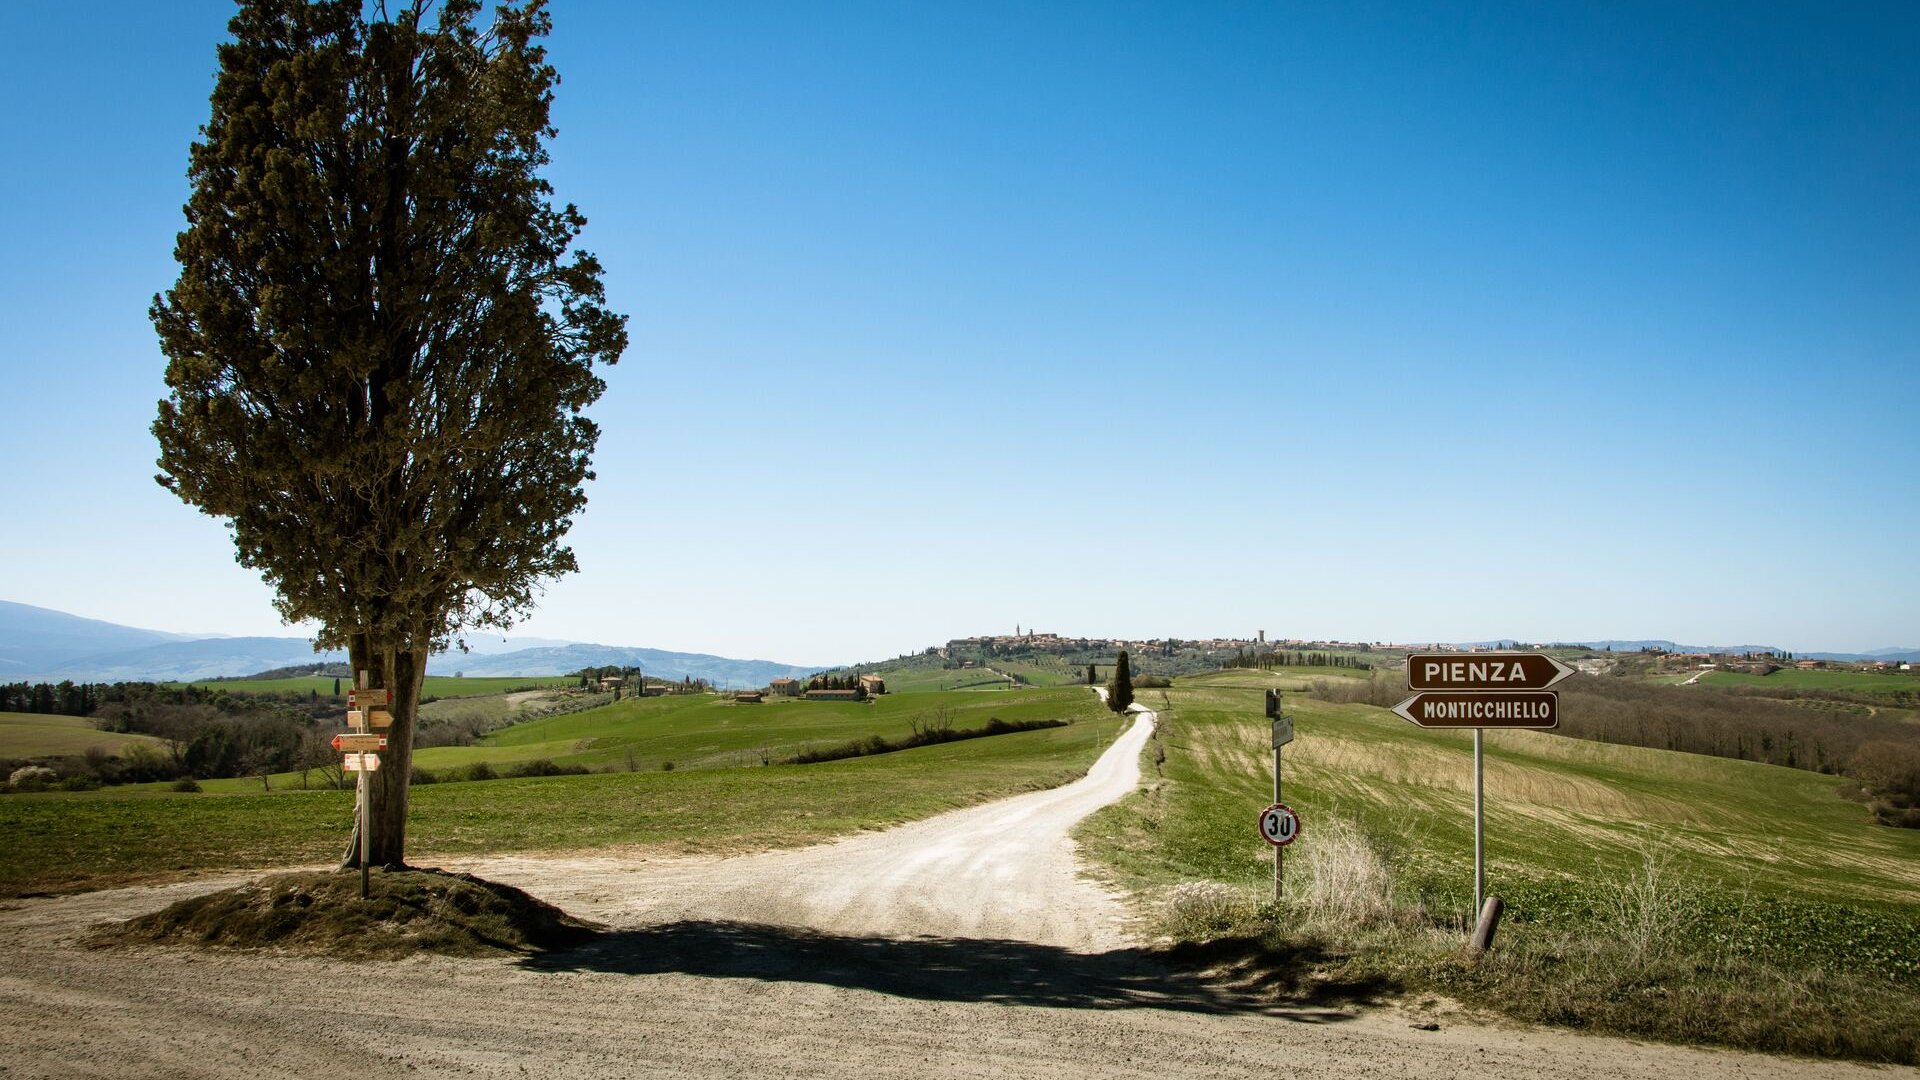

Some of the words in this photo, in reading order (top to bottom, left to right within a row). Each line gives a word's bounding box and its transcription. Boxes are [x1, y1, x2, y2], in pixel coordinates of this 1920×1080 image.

[1425, 663, 1526, 682] PIENZA
[1424, 702, 1550, 719] MONTICCHIELLO
[1268, 814, 1291, 836] 30
